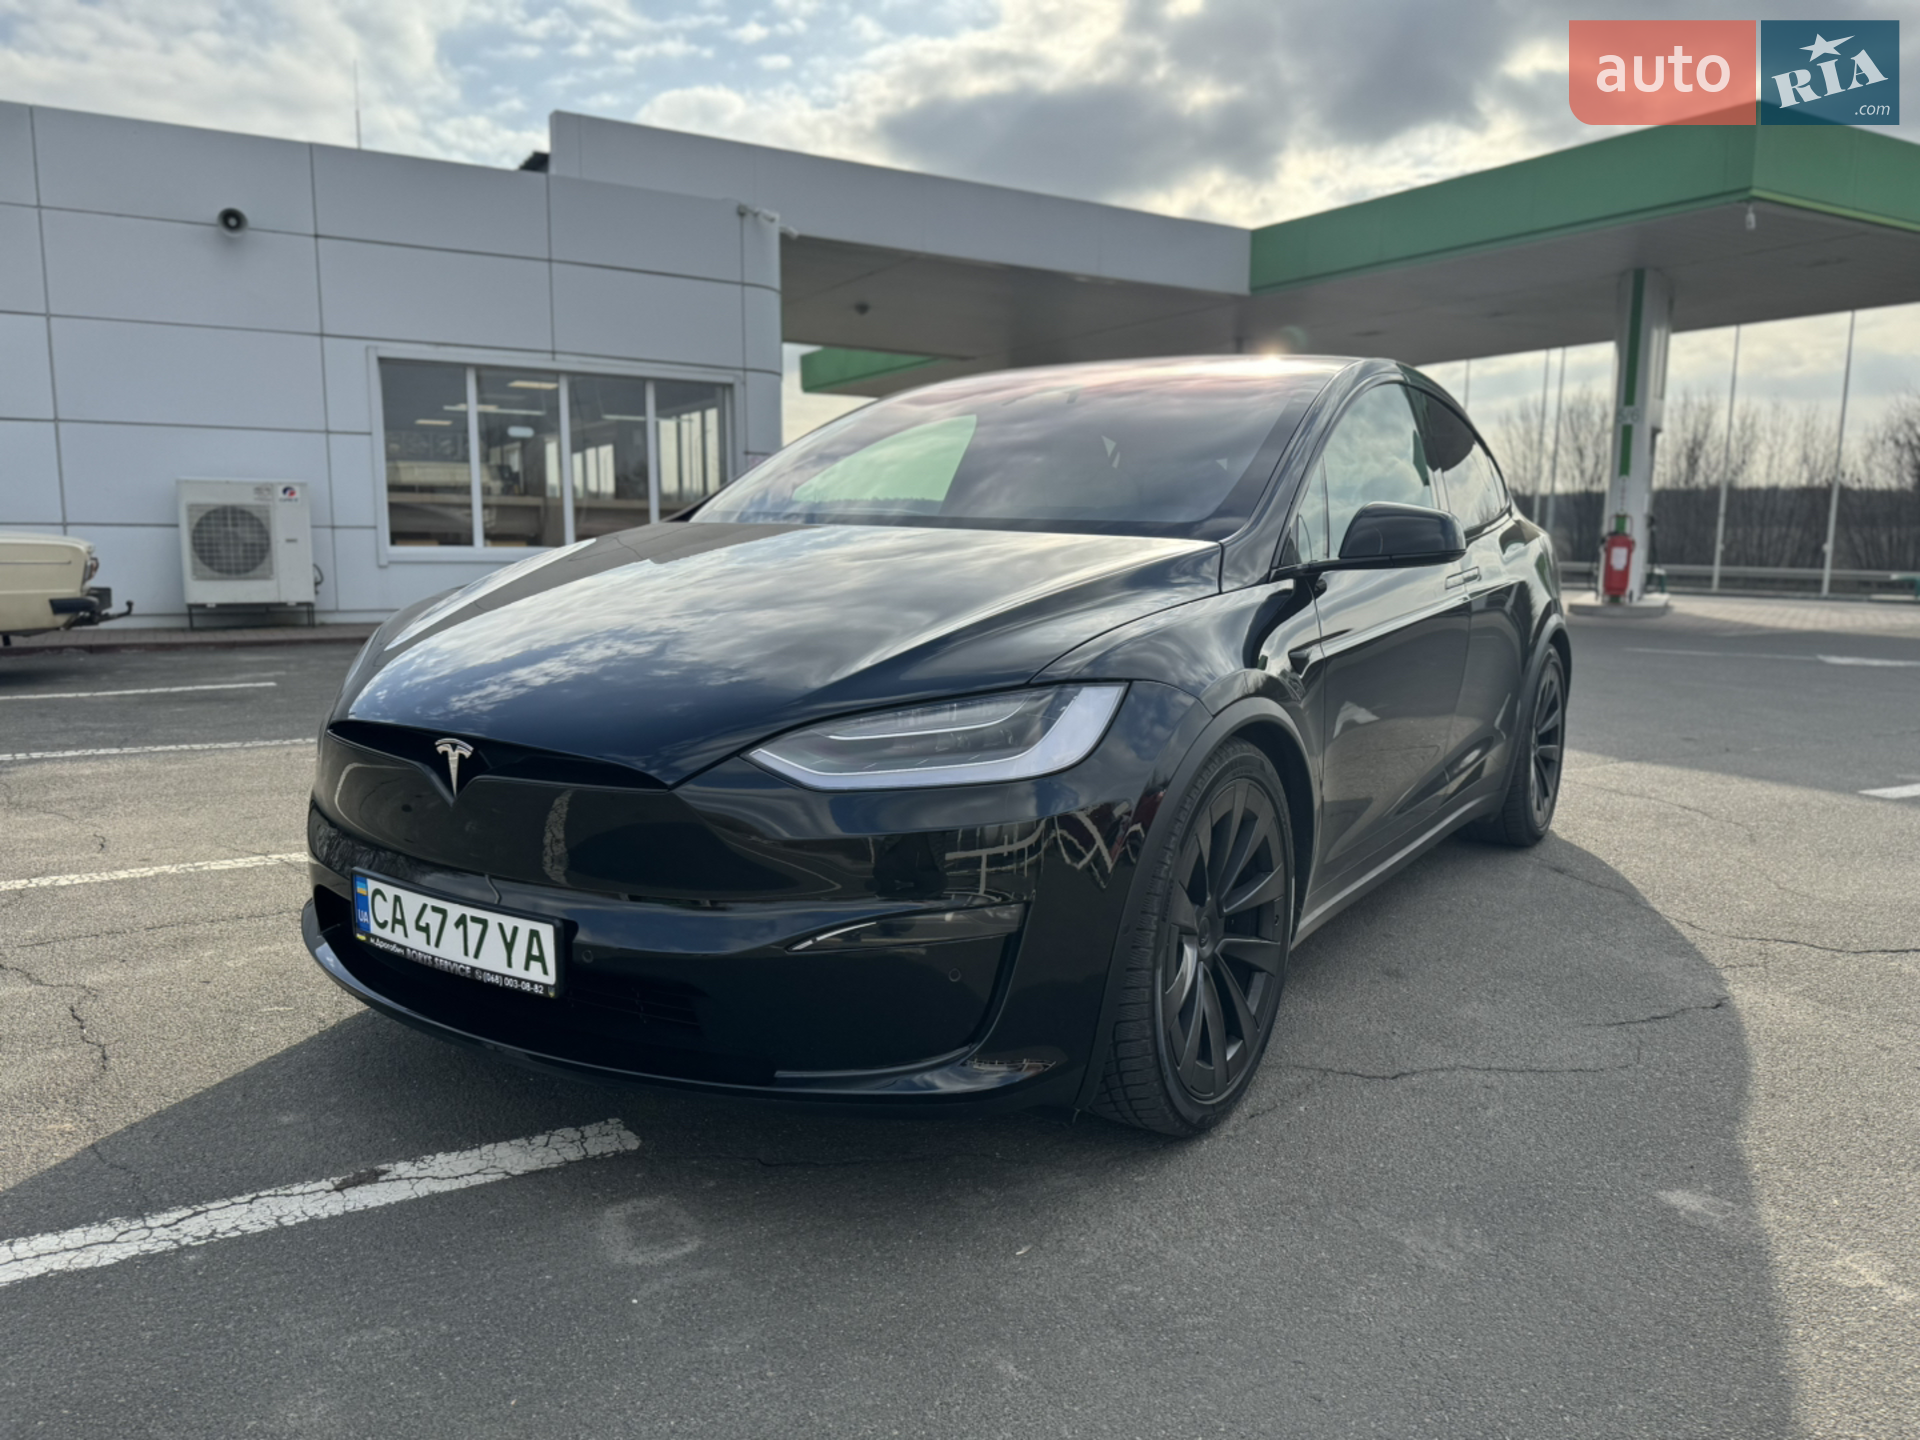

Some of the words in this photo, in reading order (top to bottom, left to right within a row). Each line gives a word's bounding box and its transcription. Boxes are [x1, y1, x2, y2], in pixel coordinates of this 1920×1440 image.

[357, 909, 370, 924] UA
[370, 887, 409, 939] CA
[414, 902, 489, 960] 4717
[497, 921, 549, 977] YA
[434, 957, 472, 977] SERVICE
